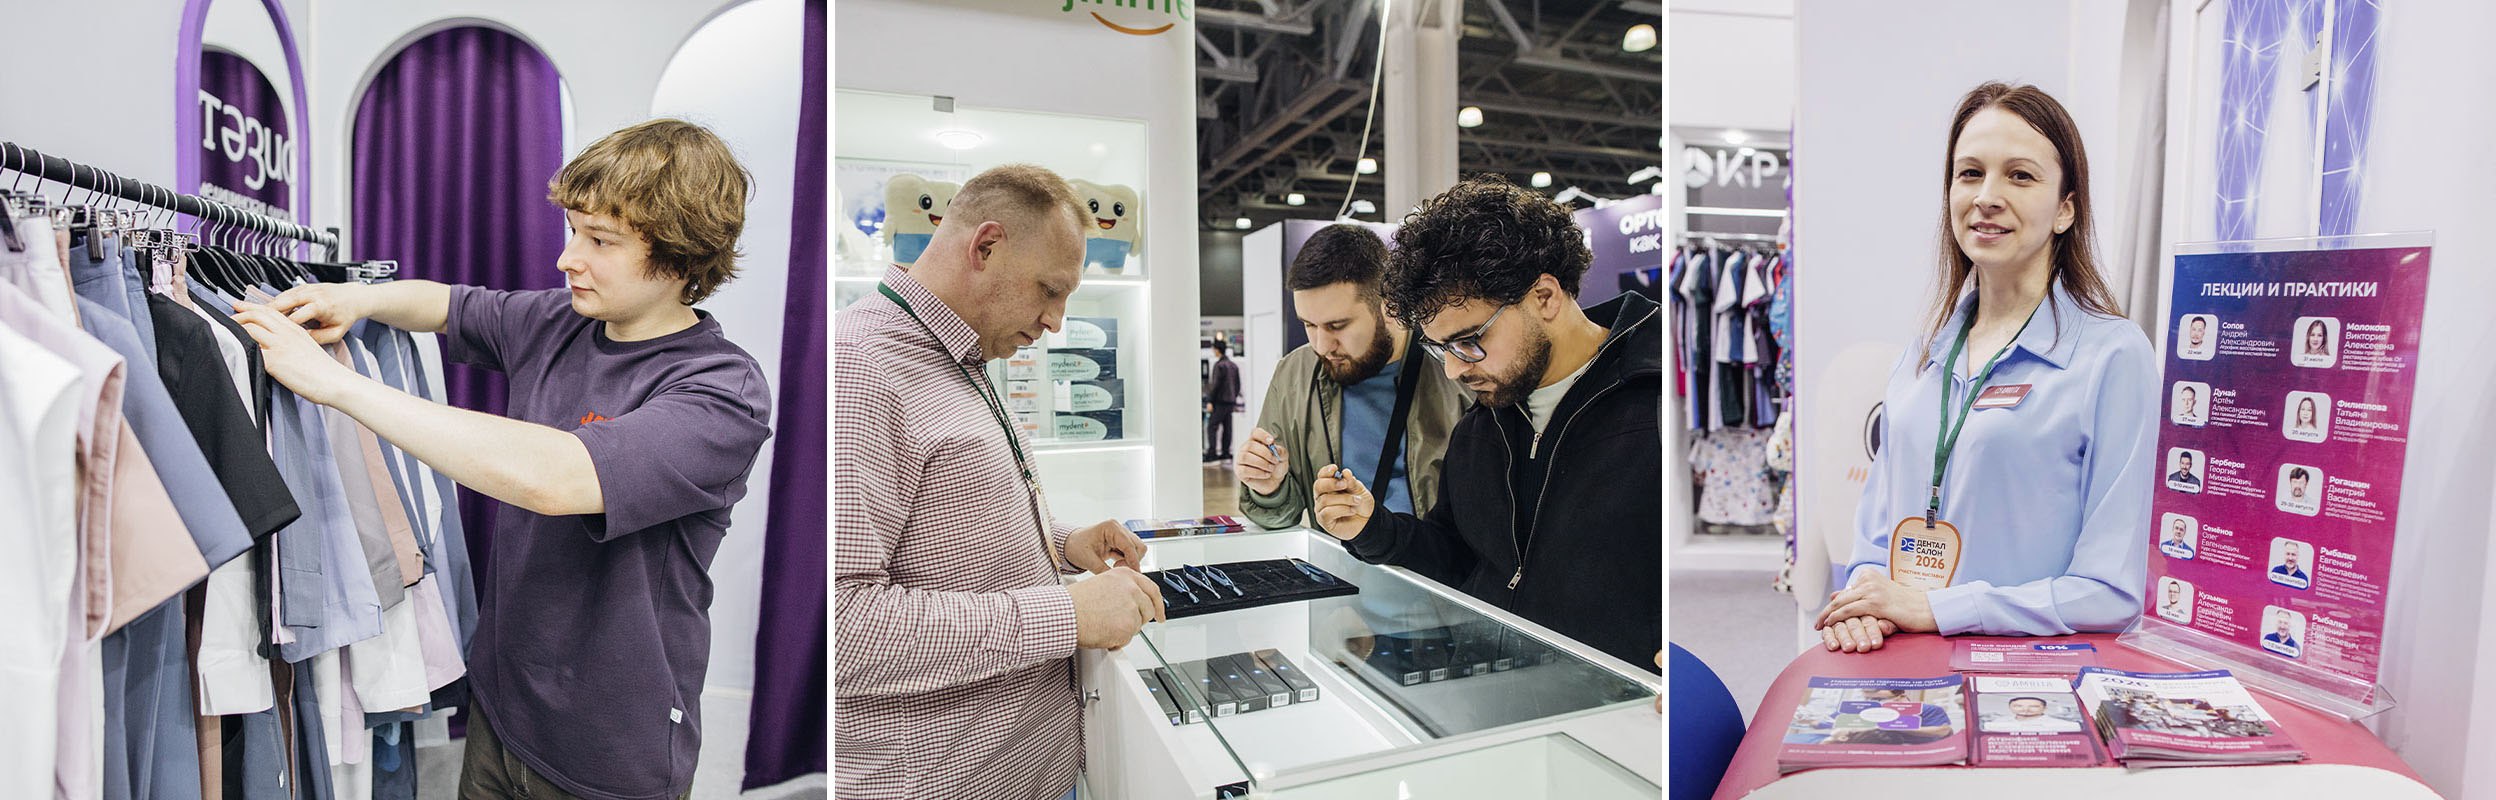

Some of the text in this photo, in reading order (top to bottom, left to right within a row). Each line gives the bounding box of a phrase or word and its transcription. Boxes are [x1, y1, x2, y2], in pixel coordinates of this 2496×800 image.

[2201, 282, 2378, 299] ЛЕКЦИИ И ПРАКТИКИ
[2222, 322, 2245, 330] Сопов
[2346, 323, 2391, 332] Молокова
[2222, 330, 2248, 339] Андрей
[2346, 332, 2387, 341] Виктория
[2220, 338, 2275, 348] Александрович
[2344, 341, 2395, 351] Алексеевна
[1051, 358, 1077, 368] mydent
[2213, 388, 2236, 397] Дунай
[2213, 396, 2234, 405] Артём
[2336, 400, 2388, 412] Филиппова
[2212, 404, 2266, 416] Александрович
[2336, 408, 2368, 419] Татьяна
[1060, 420, 1085, 430] mydent
[2336, 417, 2399, 431] Владимировна
[2210, 458, 2245, 469] Берберов
[2210, 467, 2237, 476] Георгий
[2208, 474, 2251, 486] Михайлович
[2328, 485, 2365, 497] Дмитрий
[2327, 494, 2376, 508] Васильевич
[2202, 524, 2233, 536] Семёнов
[2202, 532, 2218, 541] Олег
[1916, 540, 1946, 550] ДЕНТАЛ
[2202, 540, 2240, 553] Евгеньевич
[1916, 548, 1943, 557] САЛОН
[2320, 547, 2357, 561] Рыбалка
[1916, 555, 1945, 570] 2026
[2320, 556, 2353, 569] Евгений
[2318, 564, 2368, 581] Николаевич
[2198, 592, 2228, 605] Кузьмин
[2198, 599, 2234, 615] Александр
[2197, 606, 2232, 621] Сергеевич
[2312, 614, 2348, 630] Рыбалка
[2312, 622, 2345, 637] Евгений
[2312, 631, 2359, 650] Николаевич
